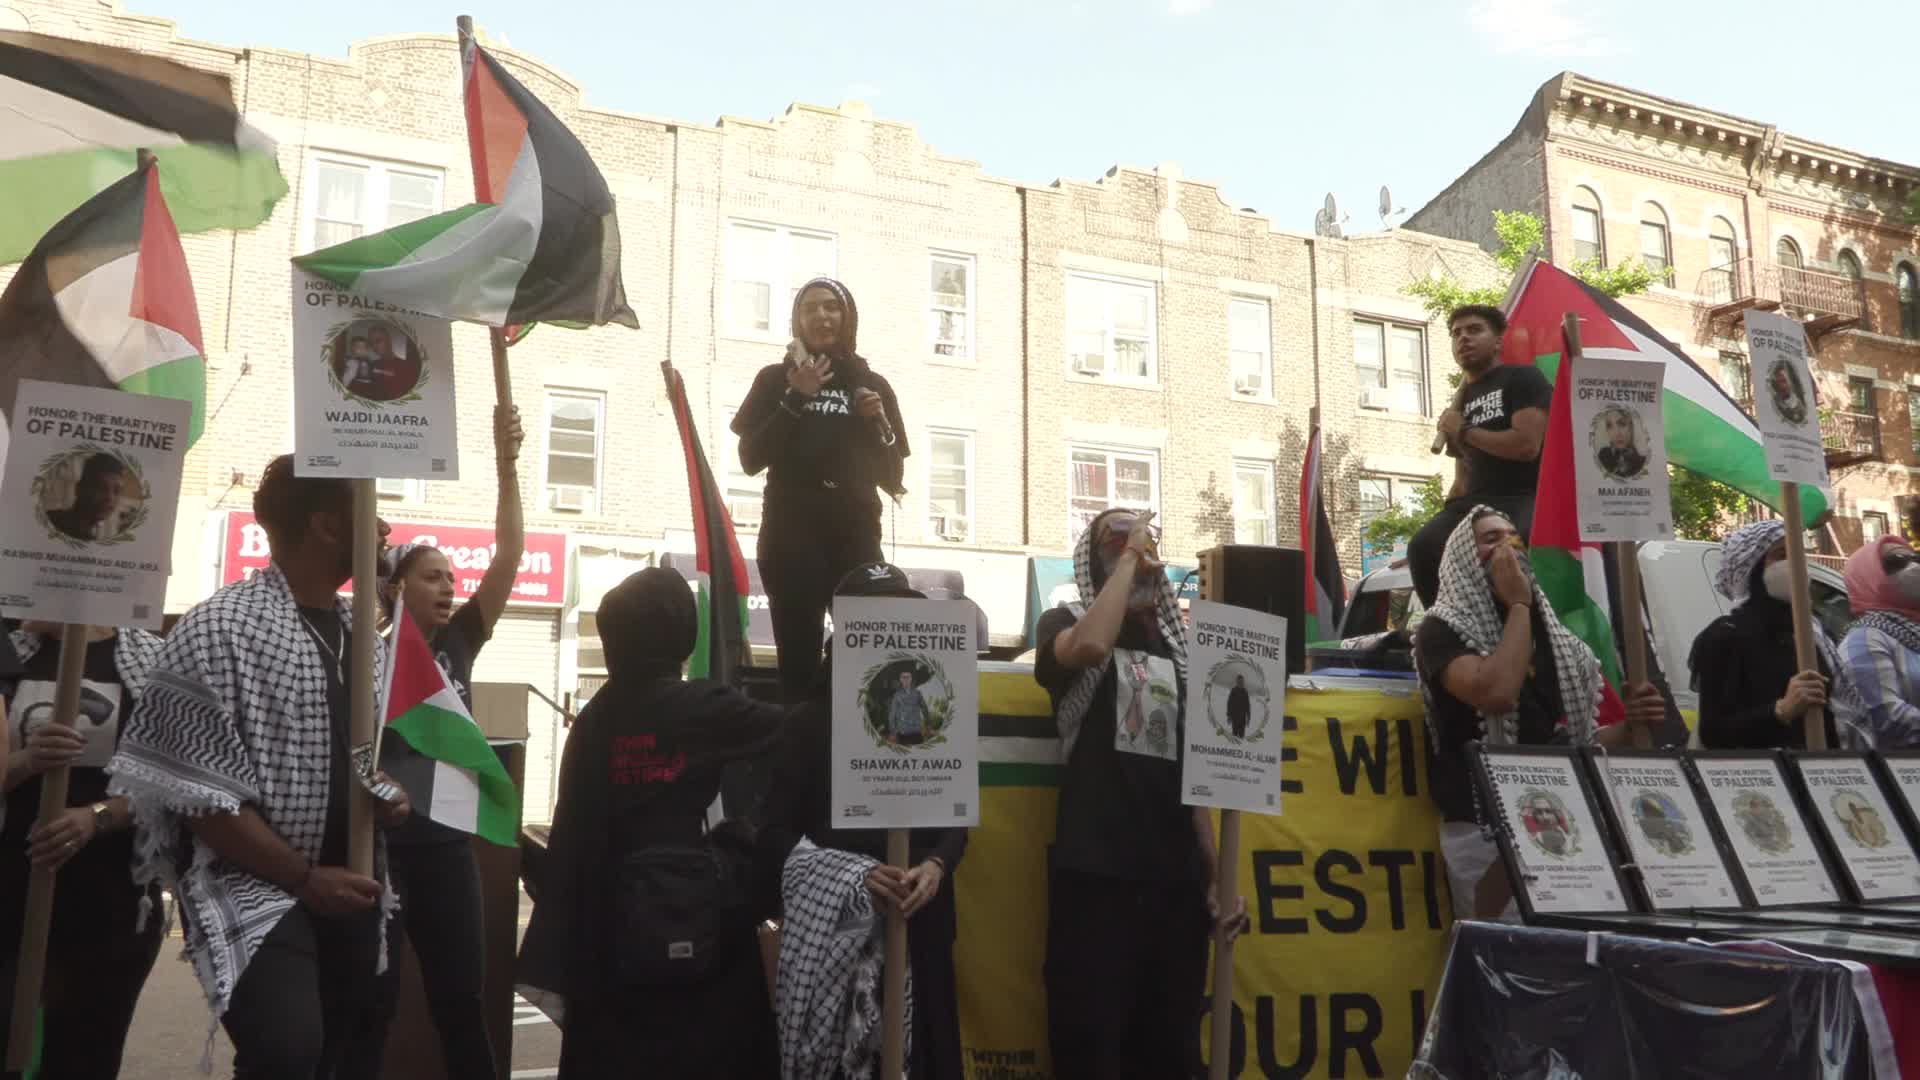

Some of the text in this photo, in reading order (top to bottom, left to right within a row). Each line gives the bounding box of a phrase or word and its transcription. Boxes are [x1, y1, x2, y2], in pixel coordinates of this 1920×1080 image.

[306, 292, 333, 306] OF
[1578, 388, 1656, 403] OF PALESTINE
[28, 405, 177, 435] HONOR THE MARTYRS
[325, 411, 430, 427] WAJDI JAAFRA
[26, 418, 175, 451] OF PALESTINE
[1598, 487, 1651, 497] MAI AFANEH
[411, 535, 553, 574] reaon
[1173, 581, 1198, 592] FOR
[845, 620, 967, 634] HONOR THE MARTYRS
[1196, 622, 1227, 634] HONOR
[1229, 626, 1245, 638] THE
[845, 633, 967, 651] OF PALESTINE
[1196, 632, 1279, 661] OF PALESTINE
[1190, 743, 1244, 760] MOHAMMED
[1325, 716, 1419, 796] WI
[850, 758, 962, 770] SHAWKAT AWAD
[1496, 774, 1569, 787] OF PALESTINE
[1609, 775, 1680, 788] OF PALESTINE
[1725, 776, 1777, 788] PALESTINE
[1250, 848, 1443, 935] ESTI
